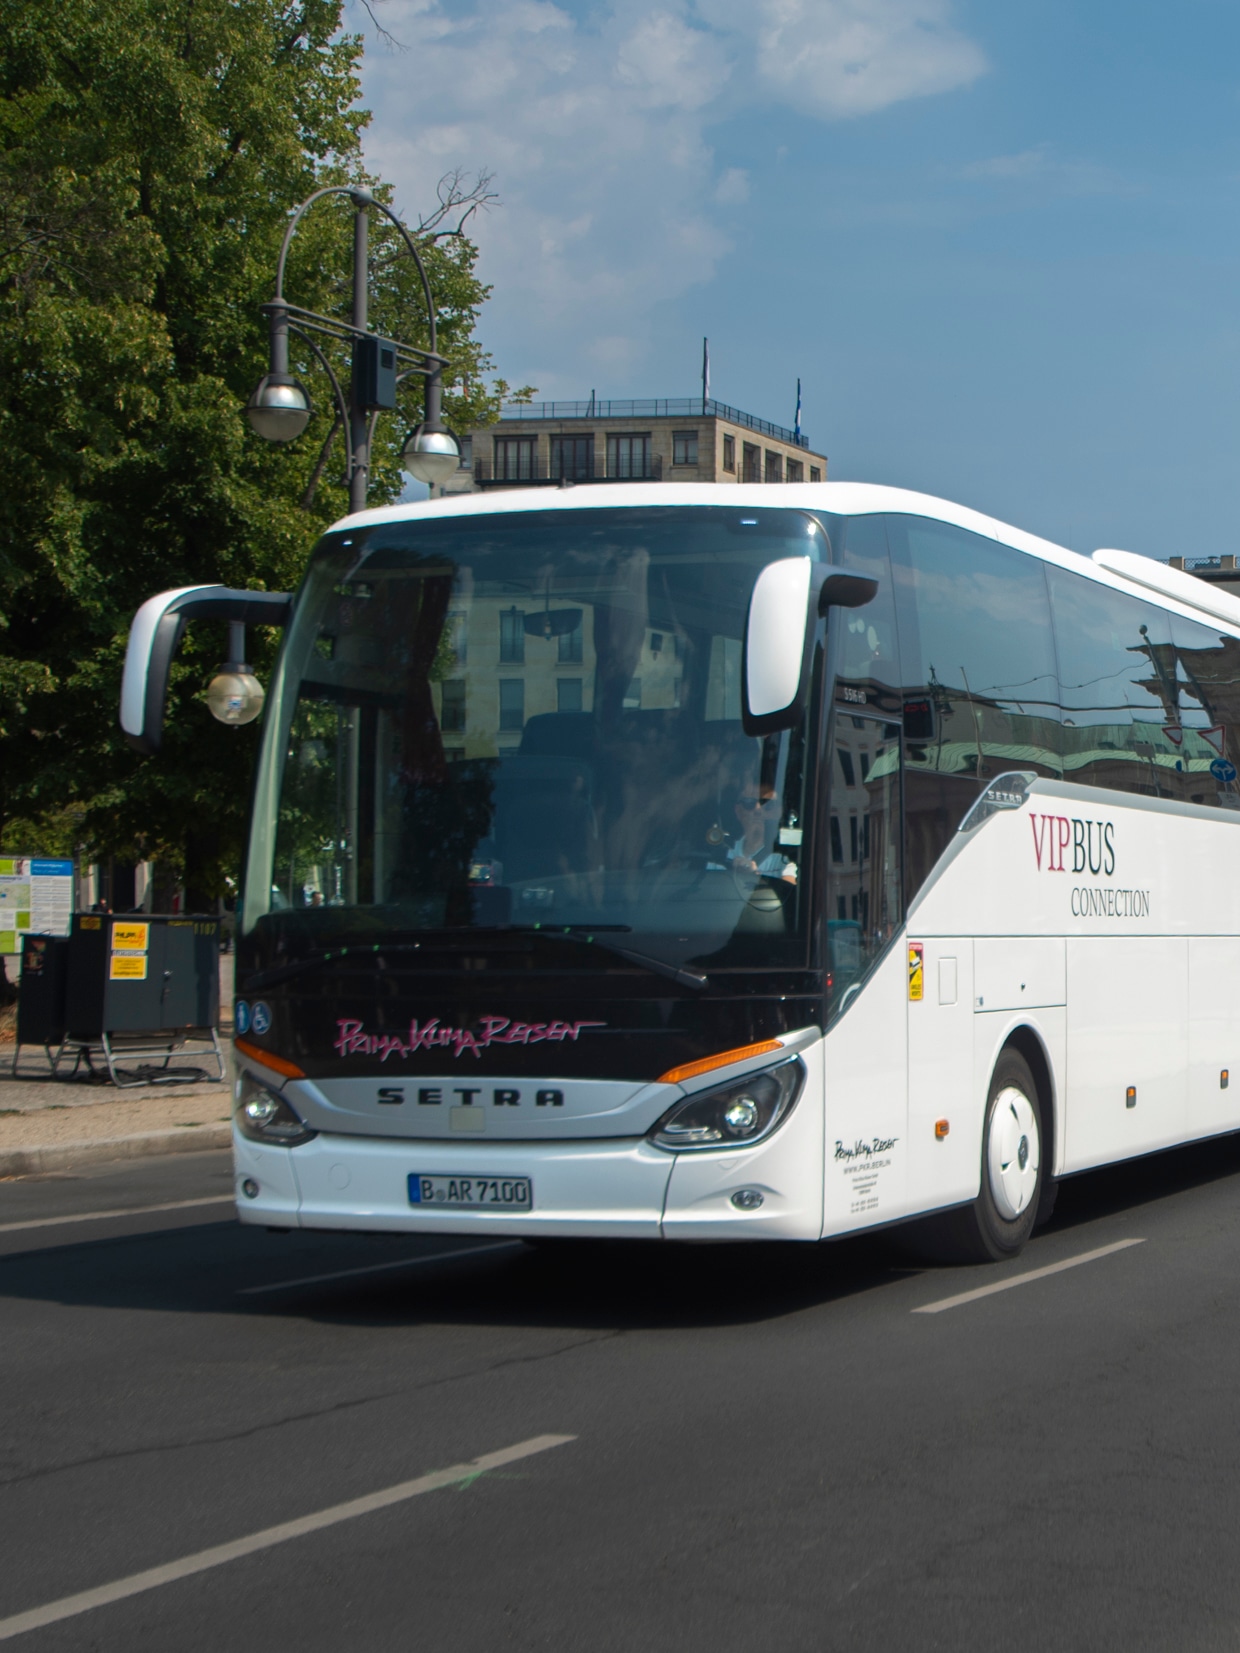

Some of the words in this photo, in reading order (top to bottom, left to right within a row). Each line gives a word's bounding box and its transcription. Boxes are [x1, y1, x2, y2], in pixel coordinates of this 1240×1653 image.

[987, 789, 1023, 804] SETRA
[1070, 887, 1151, 918] CONNECTION
[333, 1018, 409, 1063] PRIMA
[407, 1018, 485, 1058] KLIMA
[479, 1015, 608, 1047] REISEN
[376, 1087, 565, 1107] SETRA
[421, 1179, 434, 1201] B
[447, 1180, 473, 1202] AR
[476, 1181, 527, 1203] 7100
